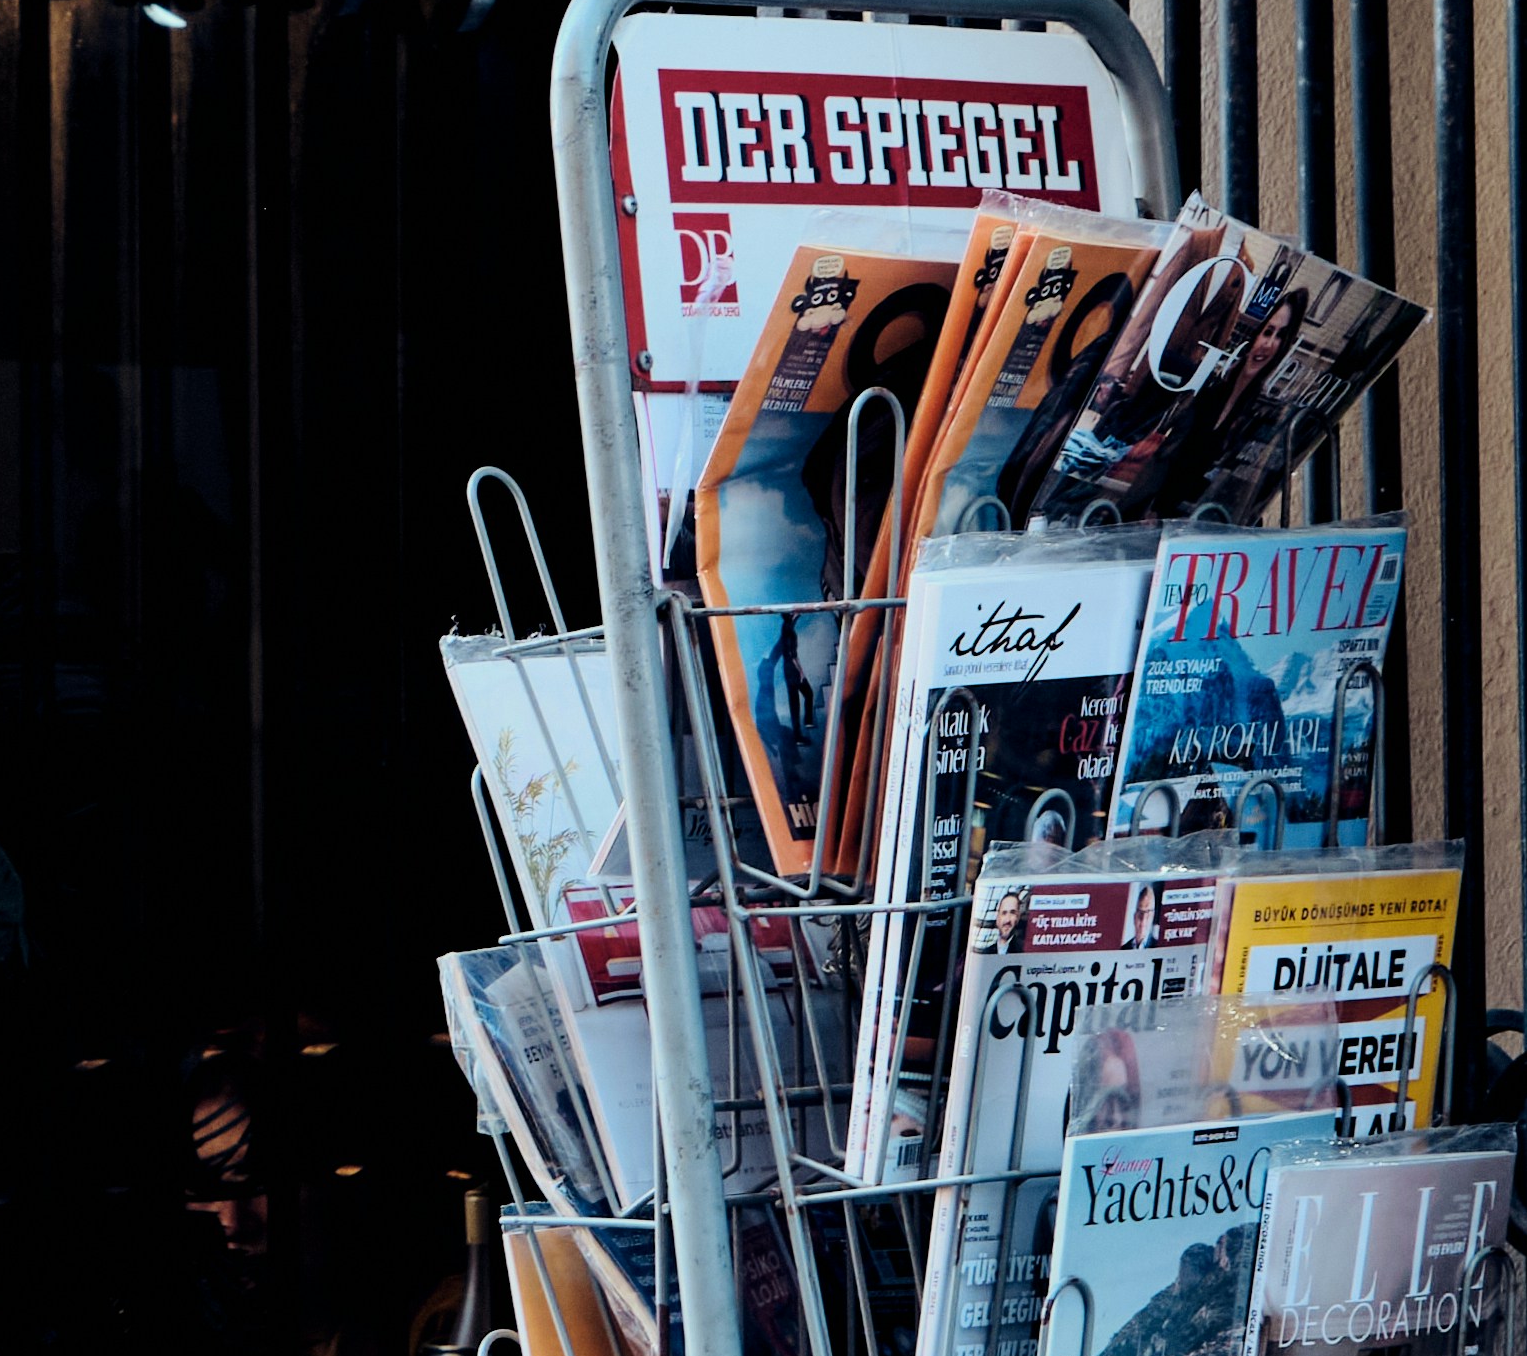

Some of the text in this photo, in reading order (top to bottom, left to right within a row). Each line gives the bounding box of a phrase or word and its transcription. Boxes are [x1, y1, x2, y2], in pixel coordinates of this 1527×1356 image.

[673, 91, 1082, 192] DER SPIEGEL
[1163, 582, 1209, 608] TEMPO
[1166, 543, 1390, 644] TRAVEL
[1147, 659, 1175, 676] 2024
[1253, 905, 1298, 923] BÜYÜK
[1379, 898, 1407, 916] YENİ
[1410, 897, 1449, 914] ROTA!
[1273, 944, 1407, 993] DİJİTALE
[984, 957, 1164, 1055] Capital
[1280, 1179, 1498, 1308] ELLE
[1277, 1288, 1484, 1349] DECORATION
